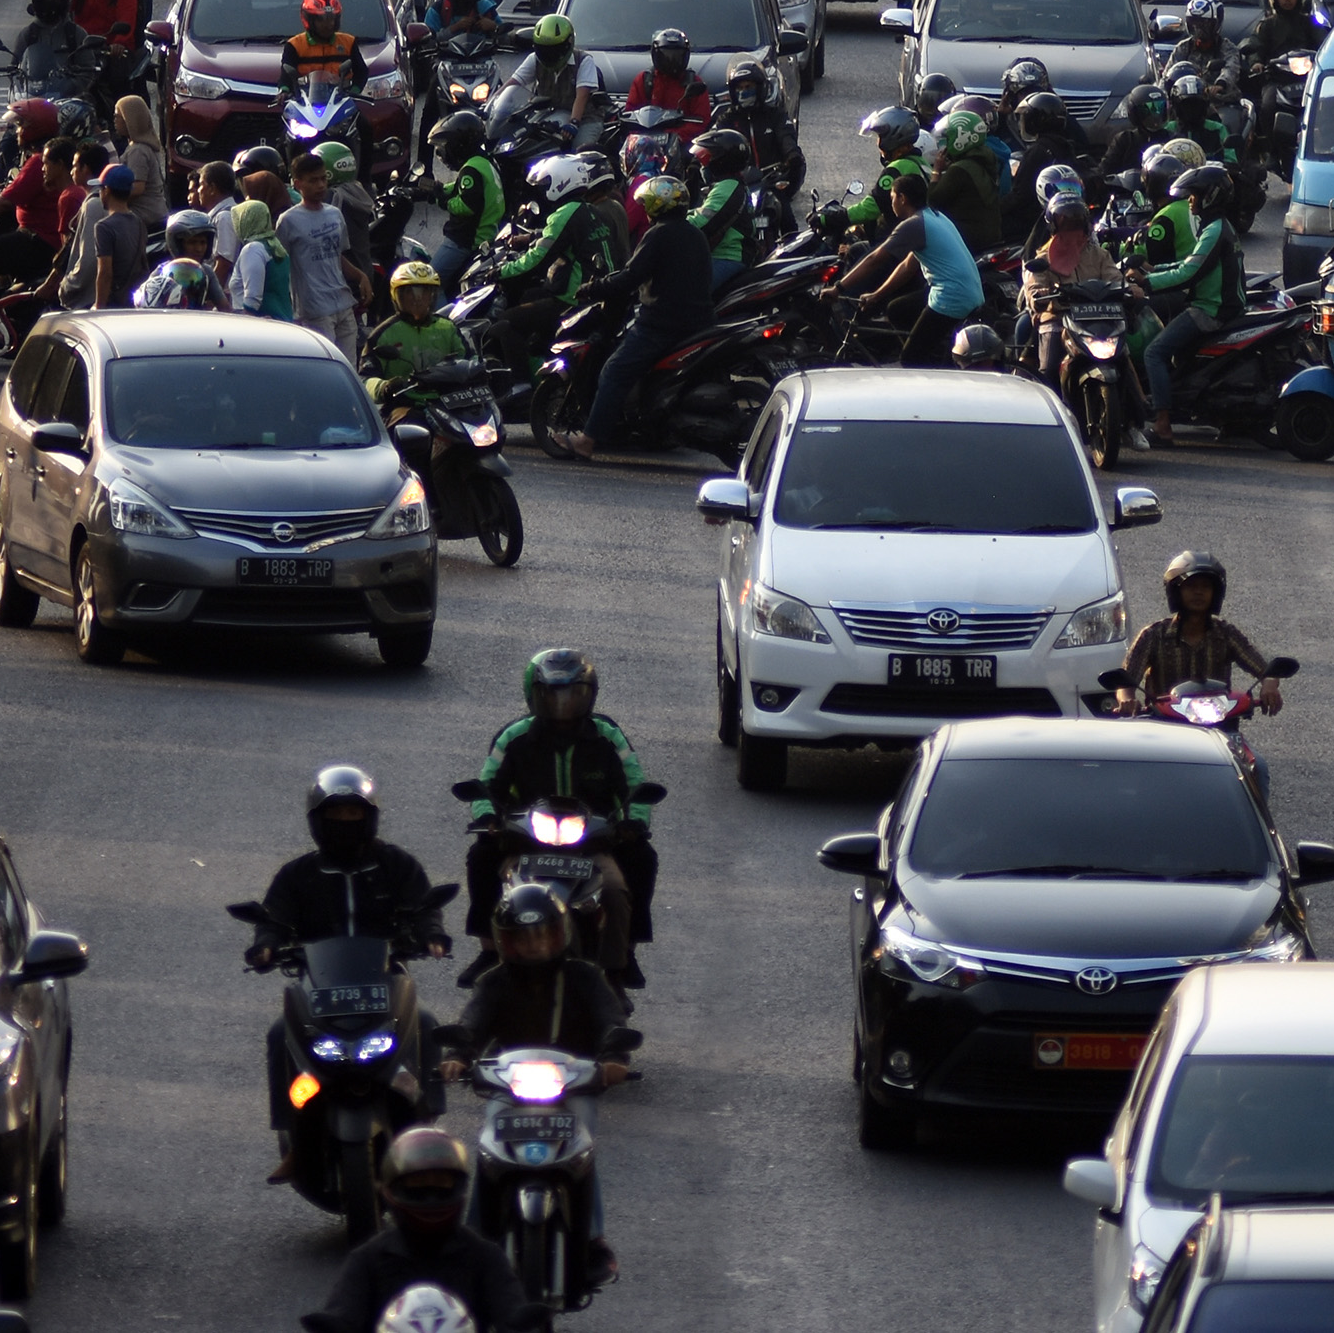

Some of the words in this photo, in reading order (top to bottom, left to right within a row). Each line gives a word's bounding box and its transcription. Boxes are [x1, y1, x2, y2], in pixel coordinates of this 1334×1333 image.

[241, 561, 249, 575] B
[264, 560, 296, 576] 1883
[308, 561, 331, 576] TRP
[893, 659, 901, 675] B
[916, 659, 951, 676] 1885
[966, 659, 992, 677] TRR
[331, 989, 361, 1001] 2739
